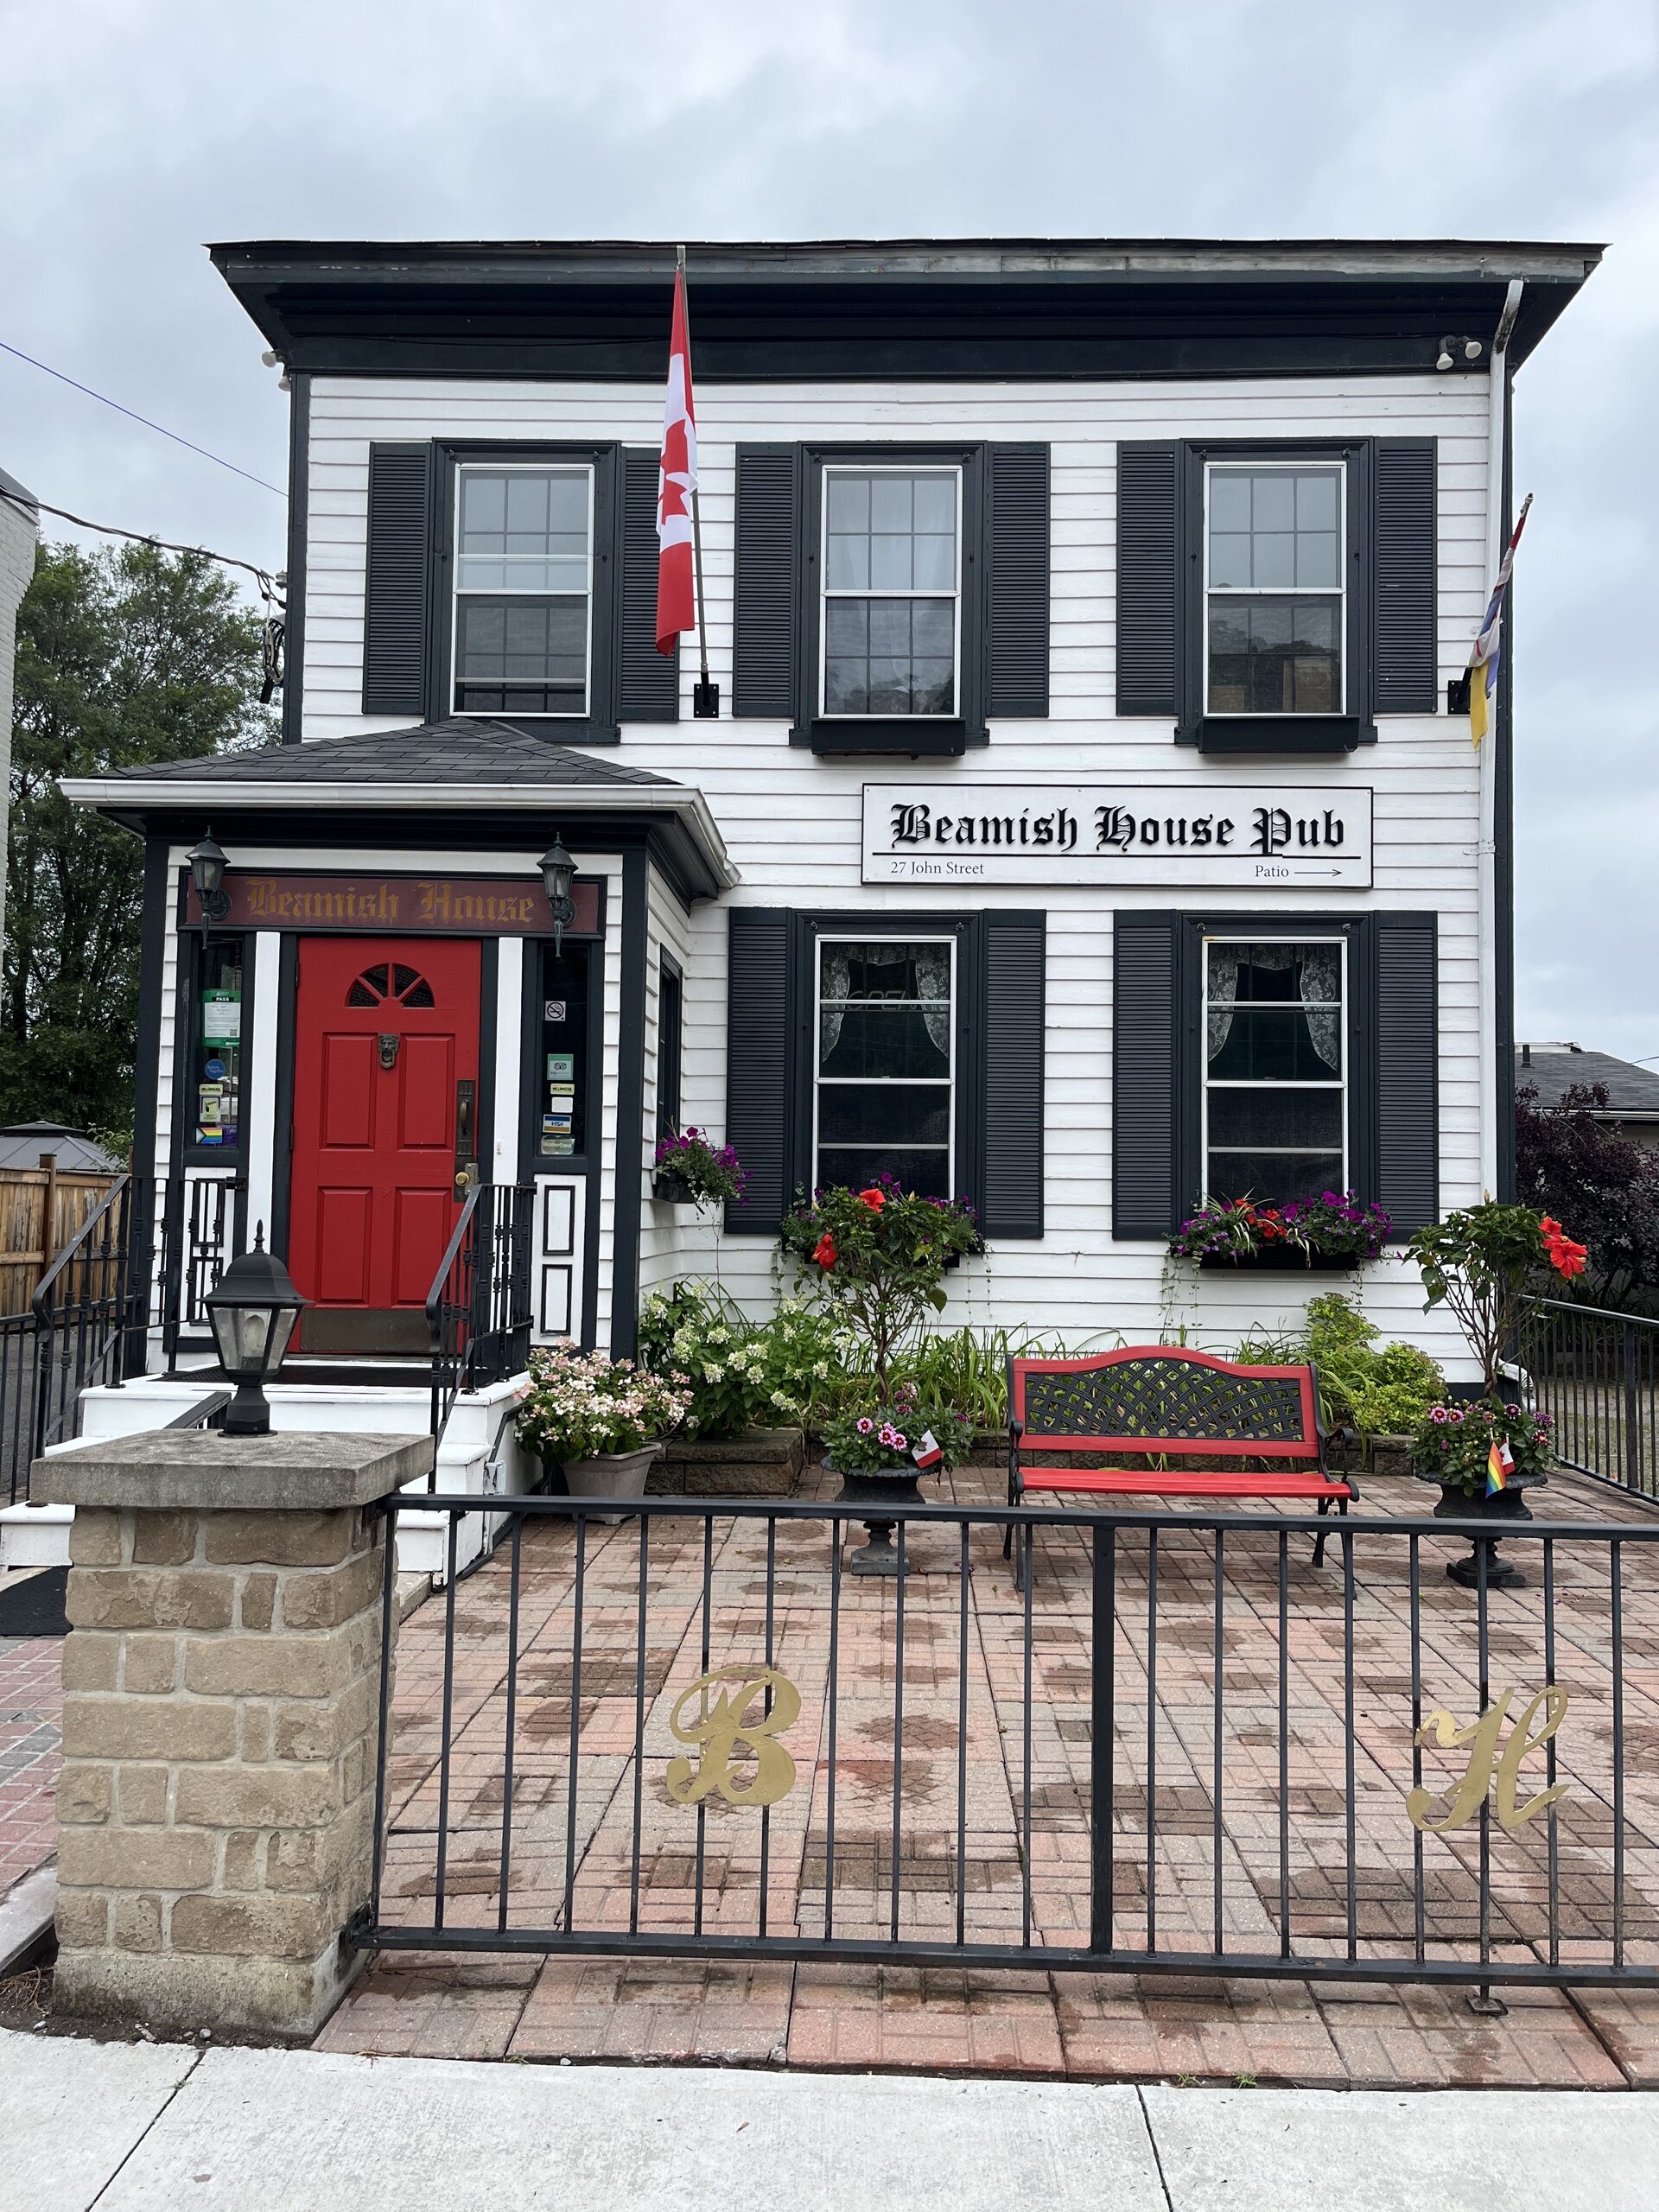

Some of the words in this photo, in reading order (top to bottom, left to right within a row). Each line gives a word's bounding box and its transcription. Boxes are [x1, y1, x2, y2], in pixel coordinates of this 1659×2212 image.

[891, 804, 1078, 852] Beamish
[1094, 805, 1235, 852] House
[1249, 807, 1344, 855] Pub
[891, 861, 906, 874] 27
[910, 861, 942, 875] John
[946, 861, 984, 875] Street
[1255, 864, 1289, 878] Patio
[246, 879, 398, 925] Beamish
[417, 880, 535, 924] House
[846, 990, 919, 1010] OPEN
[666, 1665, 802, 1805] B
[1406, 1686, 1570, 1832] H
